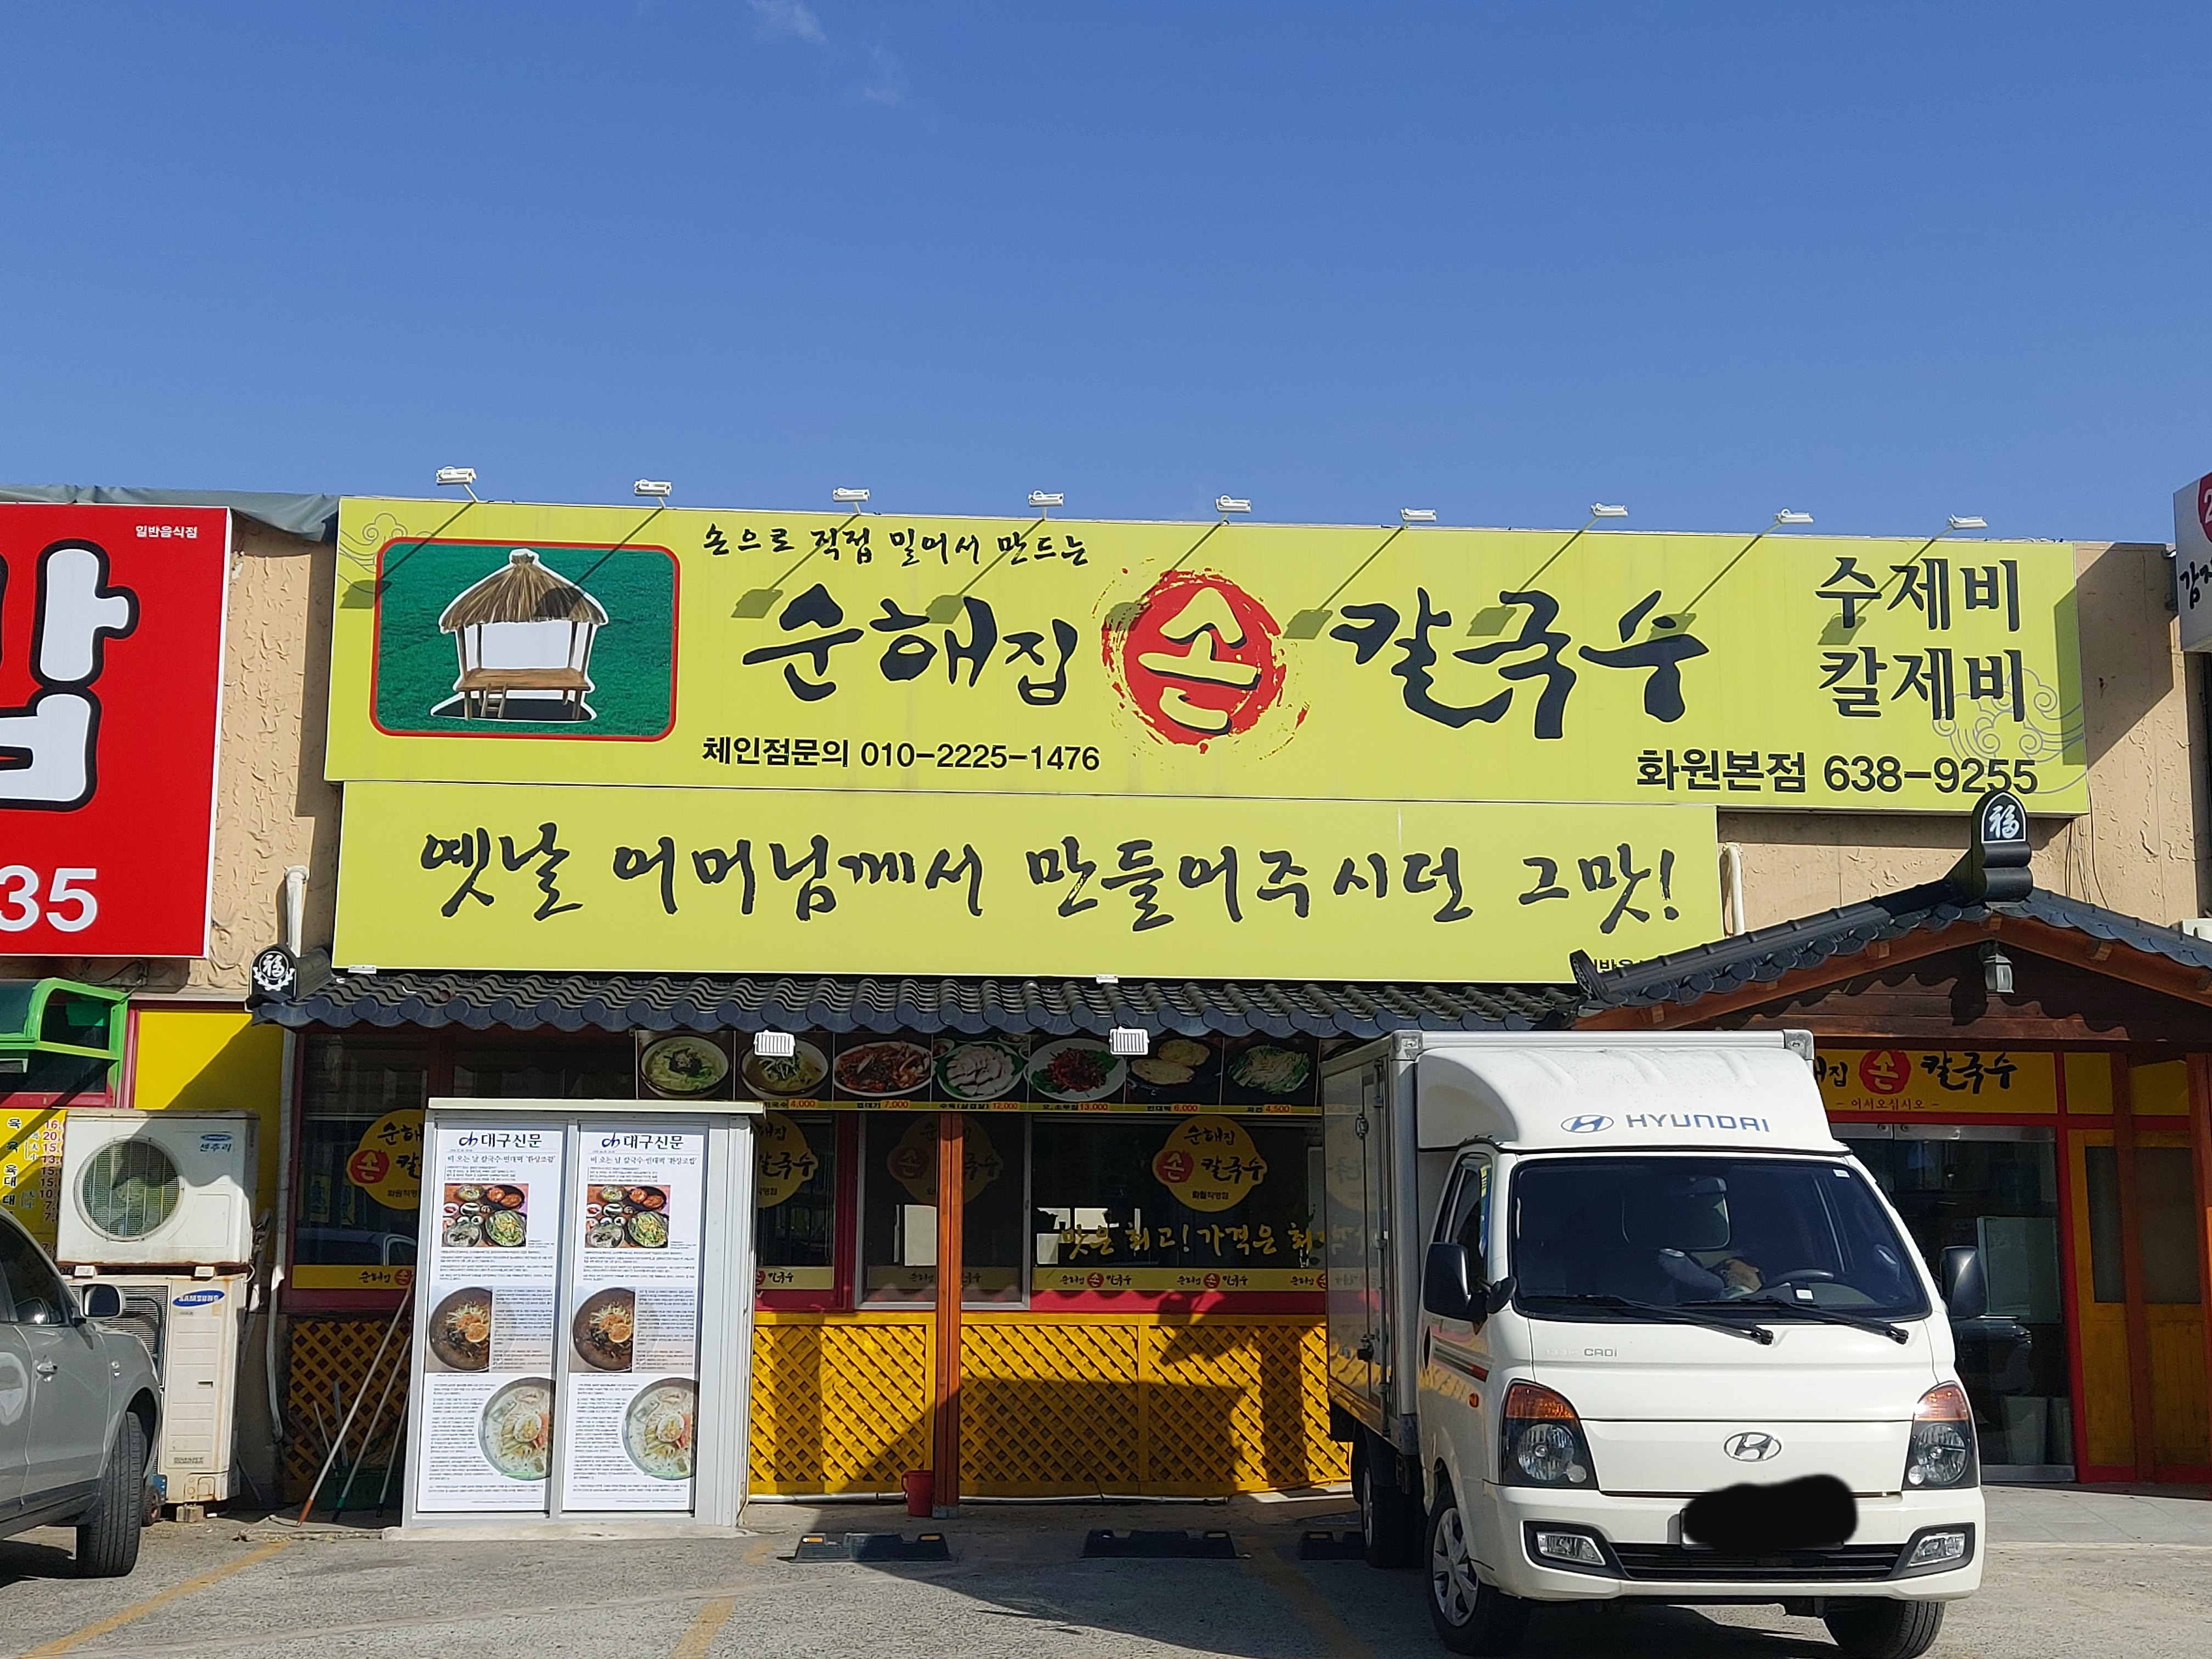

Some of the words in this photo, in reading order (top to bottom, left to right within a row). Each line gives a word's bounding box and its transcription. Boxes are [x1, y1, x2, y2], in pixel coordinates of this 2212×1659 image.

[136, 525, 198, 539] 일반음식점
[703, 523, 795, 556] 손으로
[810, 527, 873, 564] 직접
[889, 528, 980, 567] 밀어서
[997, 531, 1088, 566] 만드는
[1815, 556, 2020, 632] 수제비
[2180, 560, 2212, 610] 강
[742, 583, 1079, 706] 순해집
[1137, 586, 1261, 735] 손
[1328, 586, 1709, 739] 칼국수
[1818, 646, 2025, 723] 칼제비
[702, 736, 849, 768] 체인점문의
[860, 741, 1101, 771] 010-2225-1476
[1637, 748, 1807, 793] 화원본점
[1824, 754, 2038, 794] 638-9255
[1988, 804, 2020, 839] 福
[421, 821, 584, 921] 옛날
[613, 834, 983, 921] 어머님께서
[262, 954, 285, 978] 福
[1867, 1051, 1900, 1091] 손
[1920, 1049, 2018, 1094] 칼국수
[377, 1121, 424, 1146] 순해
[481, 1133, 543, 1148] 대구신문
[1183, 1125, 1235, 1146] 순해집
[1626, 1114, 1770, 1133] HYUNDAI
[623, 1135, 684, 1150] 대구신문
[1200, 1155, 1265, 1184] 칼국수
[1061, 1224, 1115, 1260] 맛은
[1196, 1223, 1278, 1257] 가격은
